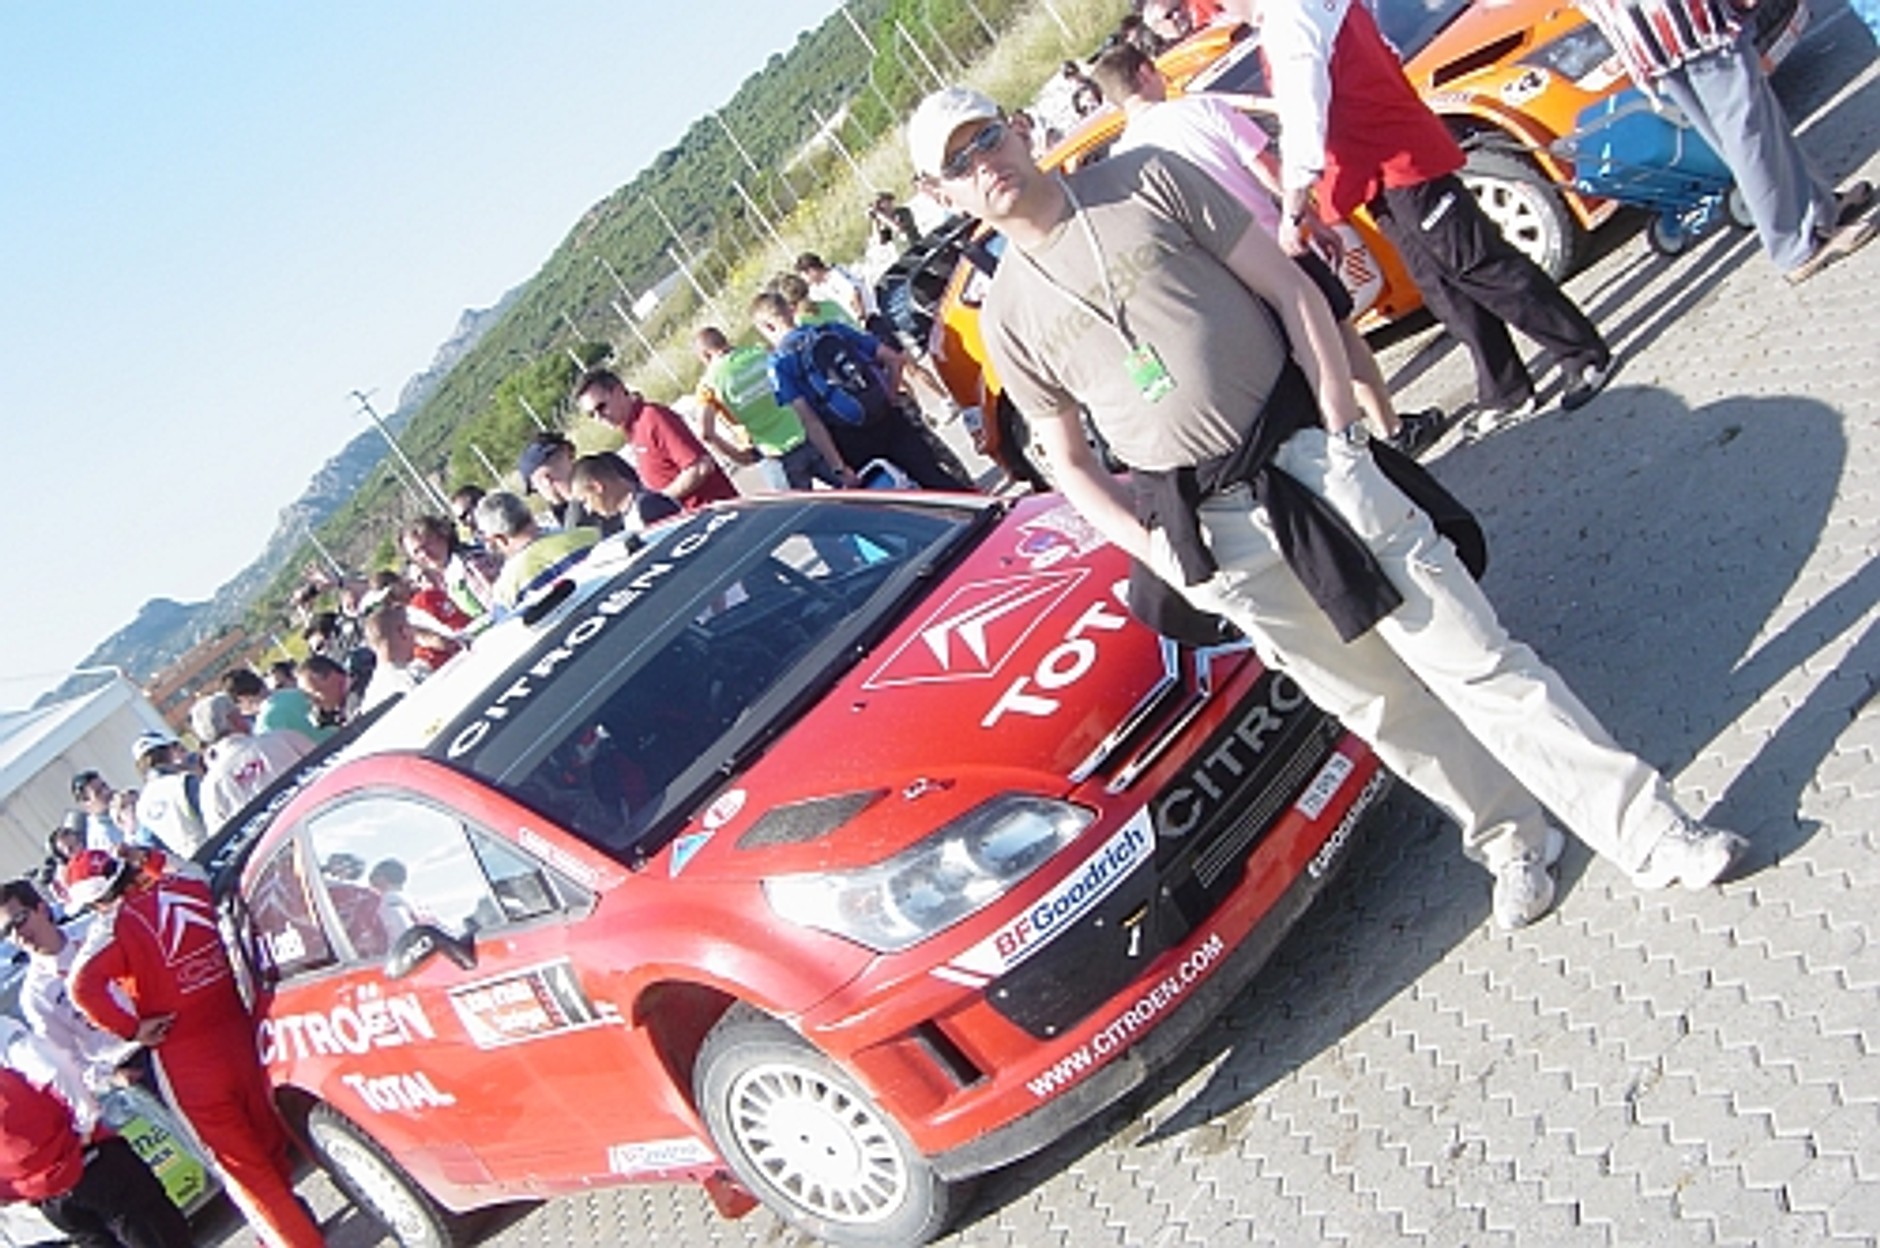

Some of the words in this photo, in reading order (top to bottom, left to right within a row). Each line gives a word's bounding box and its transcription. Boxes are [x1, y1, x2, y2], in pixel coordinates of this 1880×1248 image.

[670, 509, 739, 558] C4
[994, 828, 1146, 960] BFGoodrich
[257, 982, 437, 1065] CITROËN
[1028, 934, 1226, 1100] WWW.CITROEN.COM
[342, 1071, 456, 1113] TOTAL
